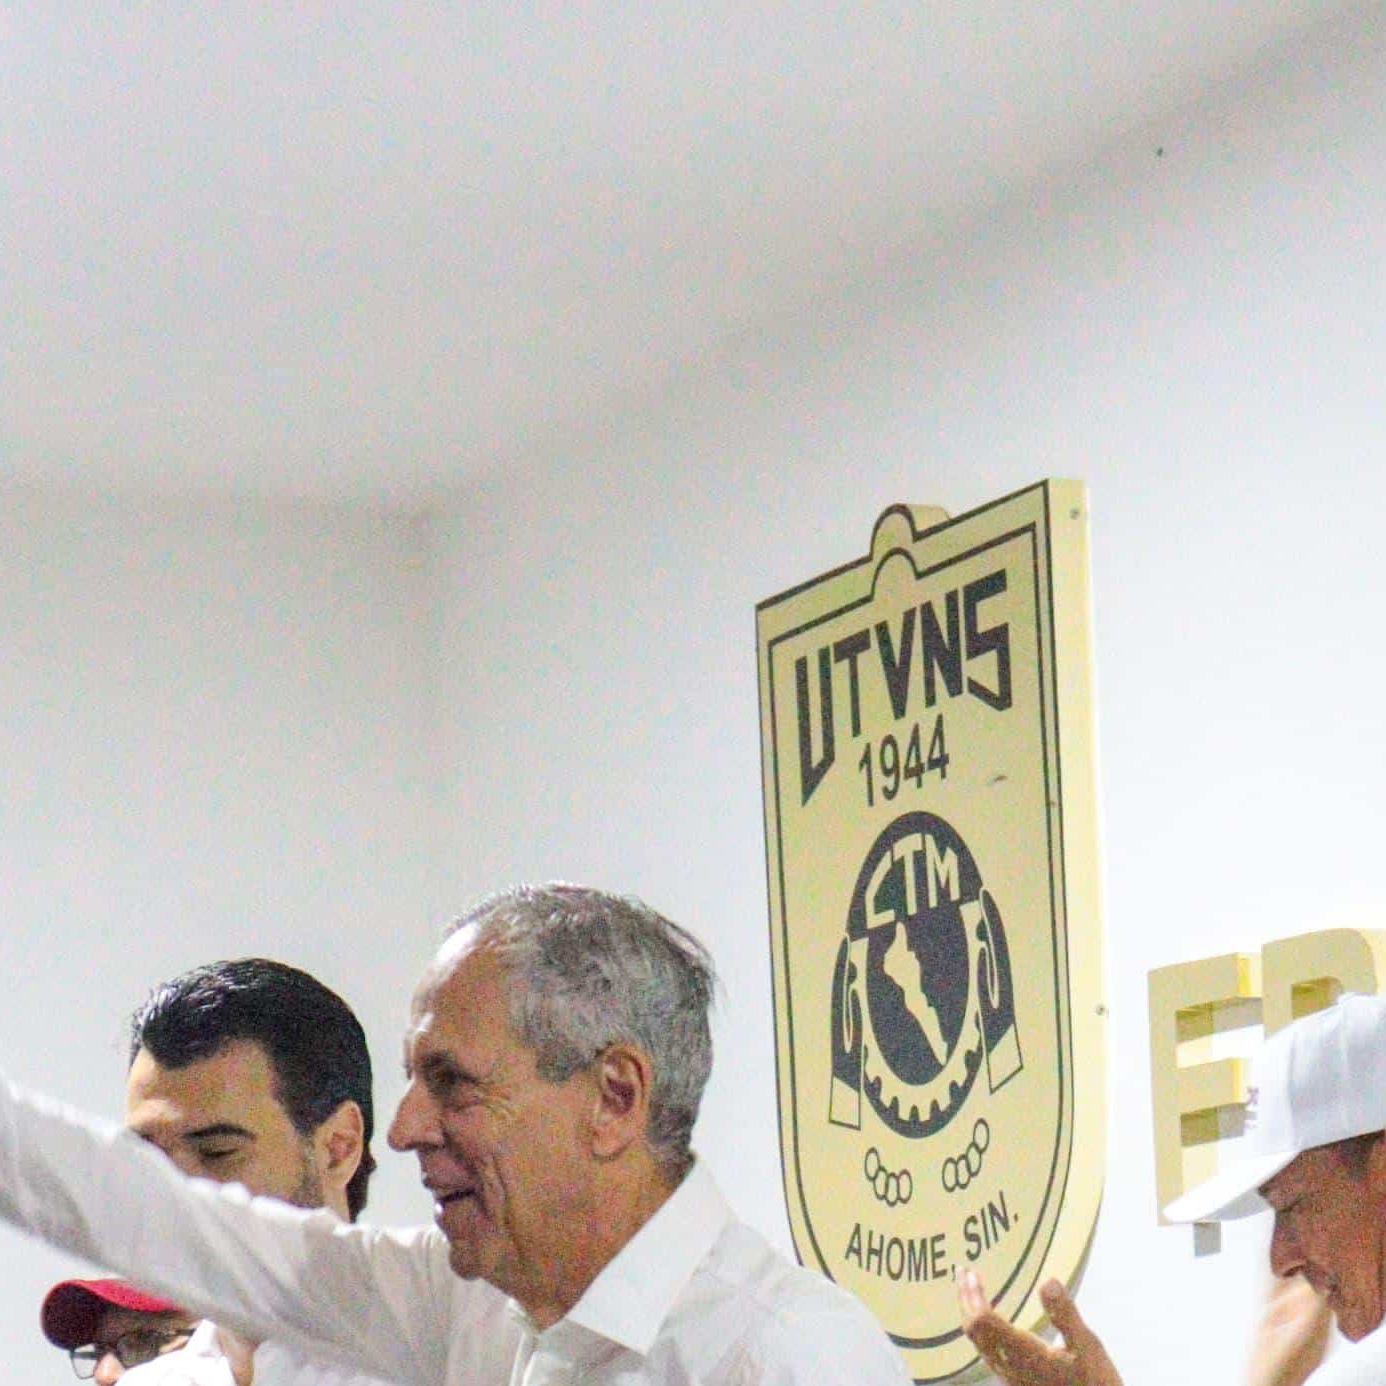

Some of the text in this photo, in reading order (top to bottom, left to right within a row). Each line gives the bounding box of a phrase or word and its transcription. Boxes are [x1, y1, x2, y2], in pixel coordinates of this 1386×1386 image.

[795, 568, 1012, 807] UTVNS
[859, 713, 949, 807] 1944
[865, 832, 961, 930] CTM
[844, 1190, 1019, 1282] AHOME, SIN.
